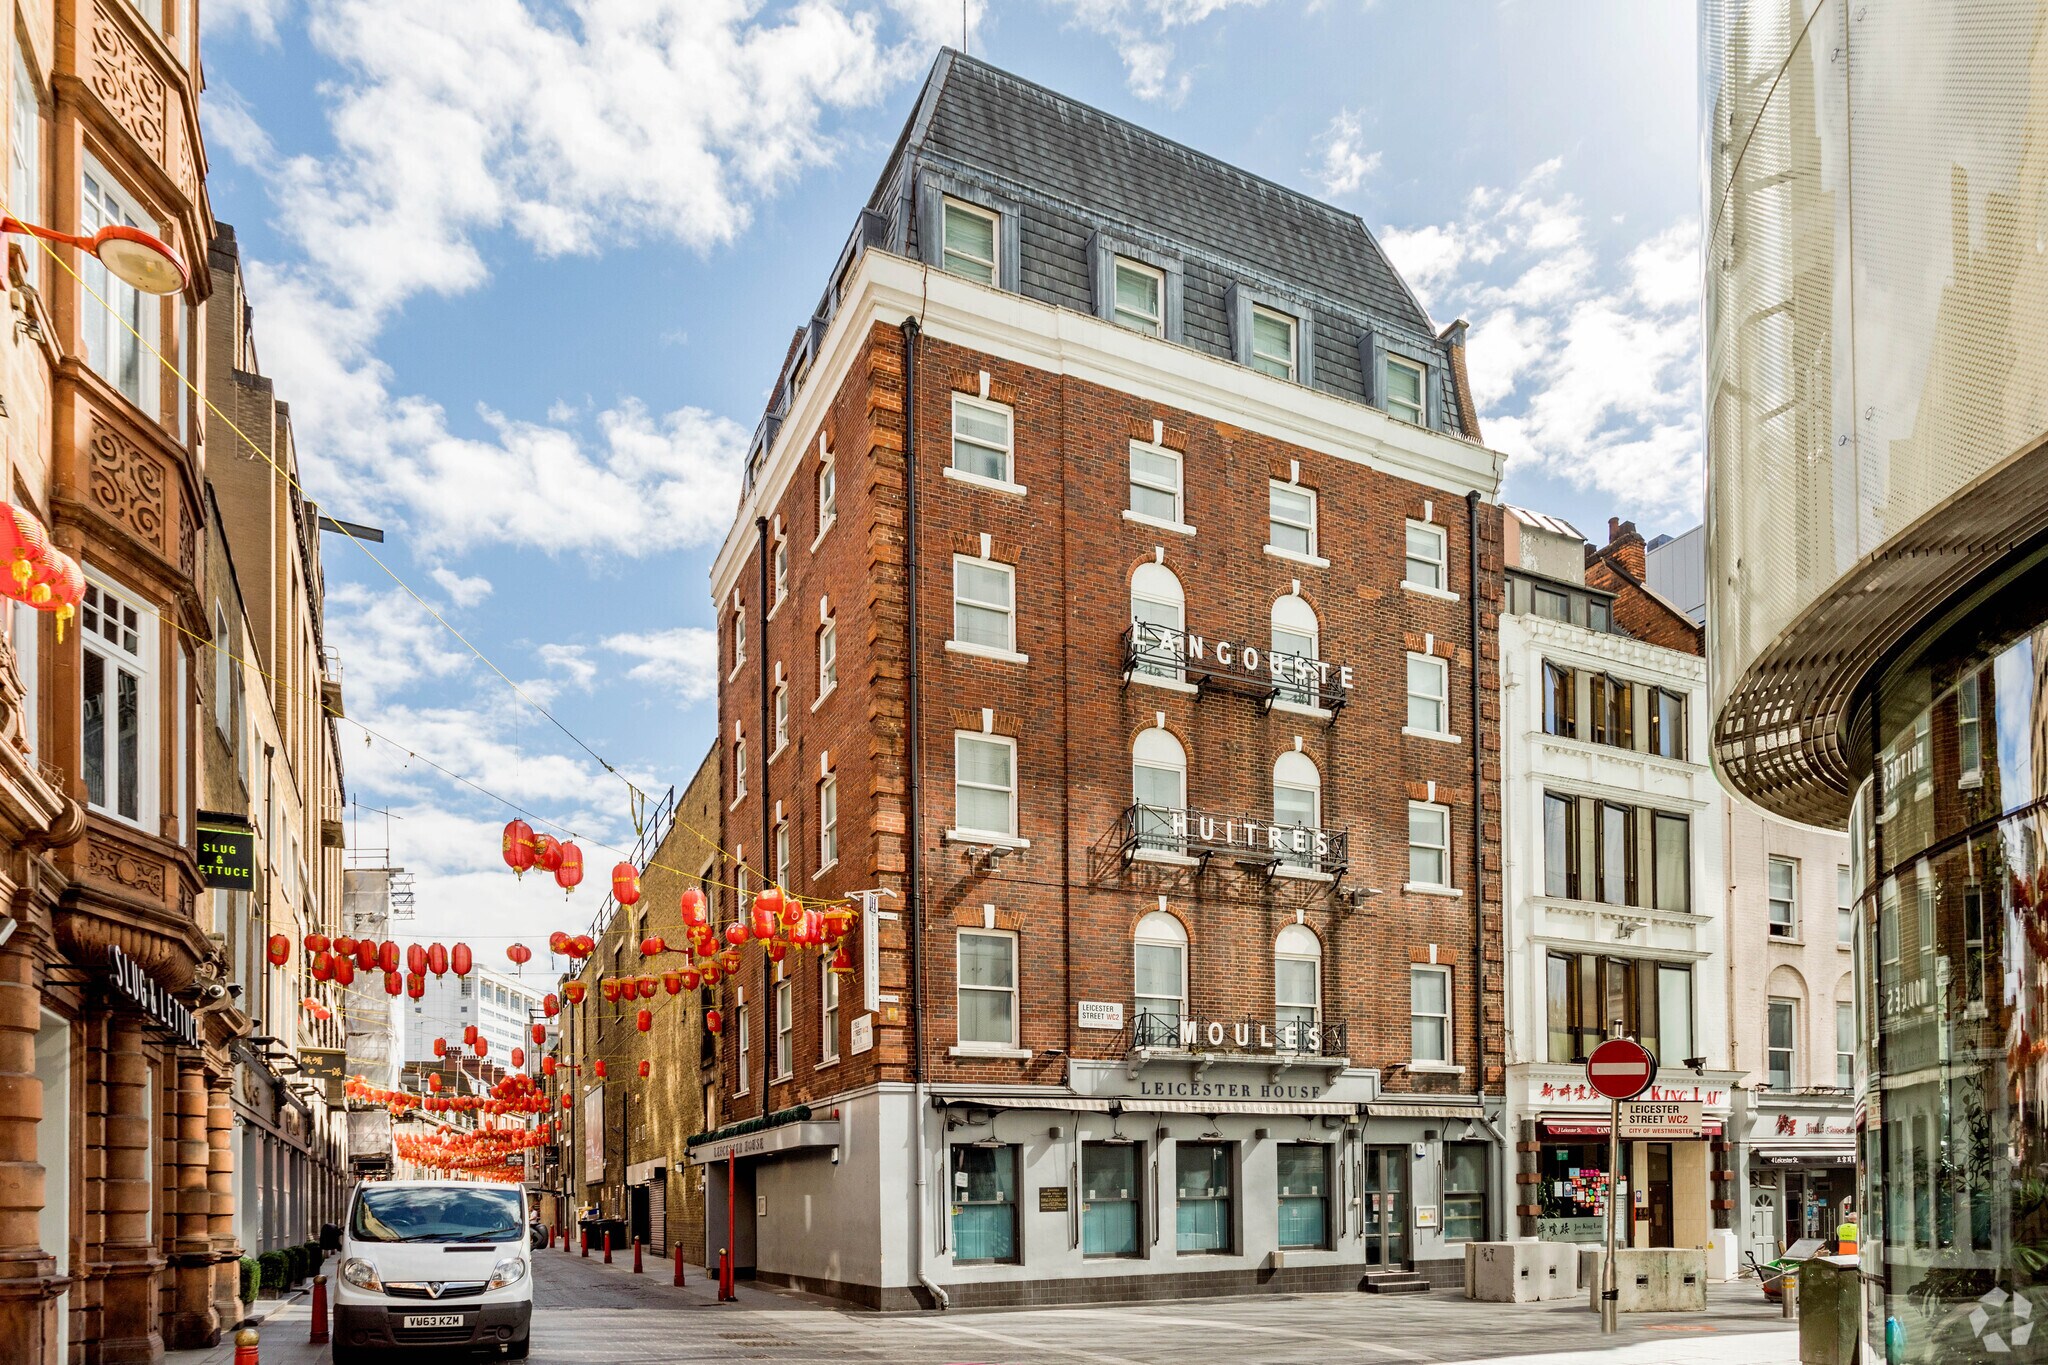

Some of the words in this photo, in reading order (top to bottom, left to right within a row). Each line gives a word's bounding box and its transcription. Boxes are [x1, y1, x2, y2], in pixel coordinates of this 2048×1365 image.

[1132, 621, 1354, 689] LANGOUSTE
[1172, 813, 1328, 856] HUITRES
[203, 843, 236, 855] SLUG
[216, 855, 224, 865] &
[198, 864, 250, 878] ETTUCE
[113, 944, 148, 1008] SLUG
[1082, 1004, 1114, 1013] LEICESTER
[1082, 1012, 1104, 1020] STREET
[1179, 1020, 1321, 1051] MOULES
[1140, 1081, 1251, 1098] LEICESTER
[1261, 1085, 1320, 1099] HOUSE
[1630, 1105, 1680, 1114] LEICESTER
[1629, 1115, 1664, 1124] STREET
[1667, 1115, 1689, 1124] WC2
[1596, 1126, 1612, 1134] CANT
[439, 1315, 460, 1326] KZM
